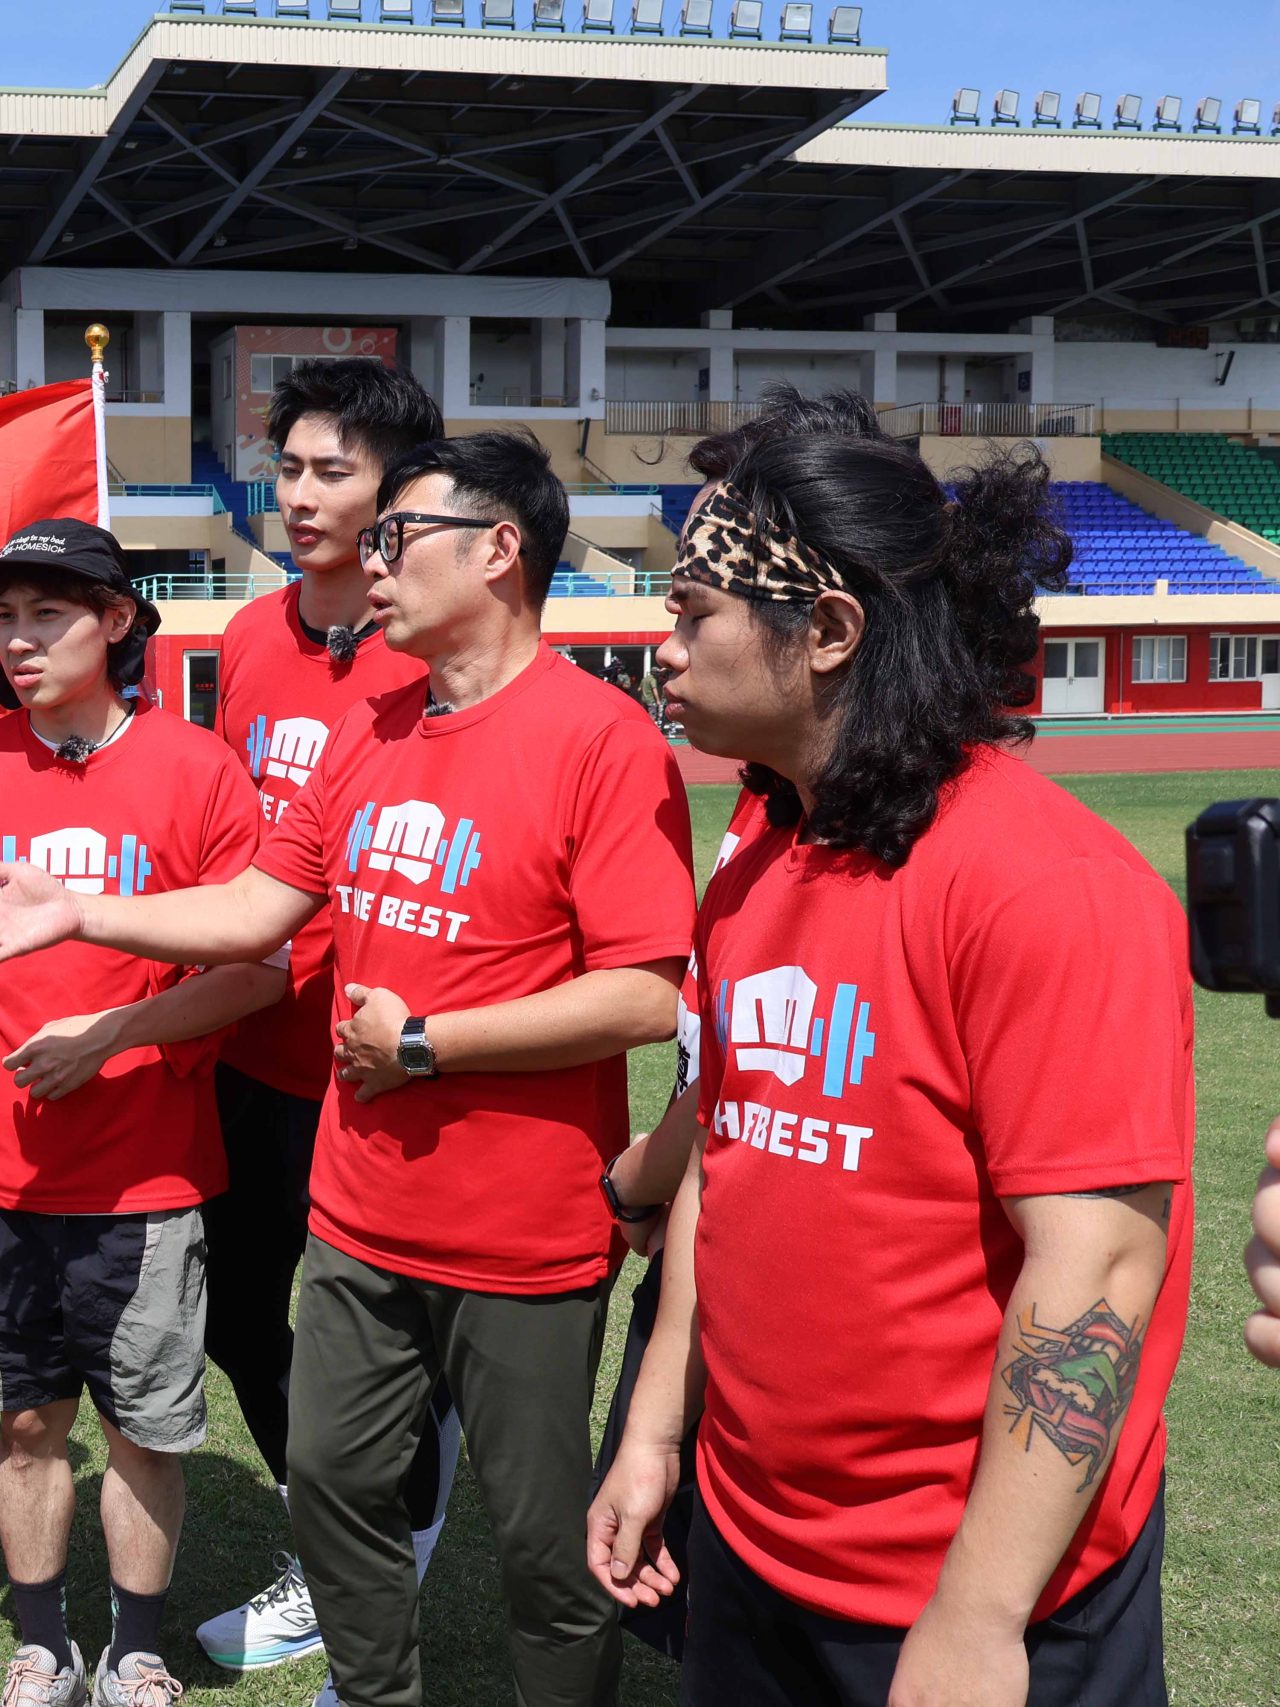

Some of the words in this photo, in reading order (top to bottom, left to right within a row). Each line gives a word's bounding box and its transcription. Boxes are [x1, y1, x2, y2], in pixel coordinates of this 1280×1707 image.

[377, 895, 471, 943] BEST
[714, 1099, 761, 1143] HE
[750, 1106, 874, 1174] BEST
